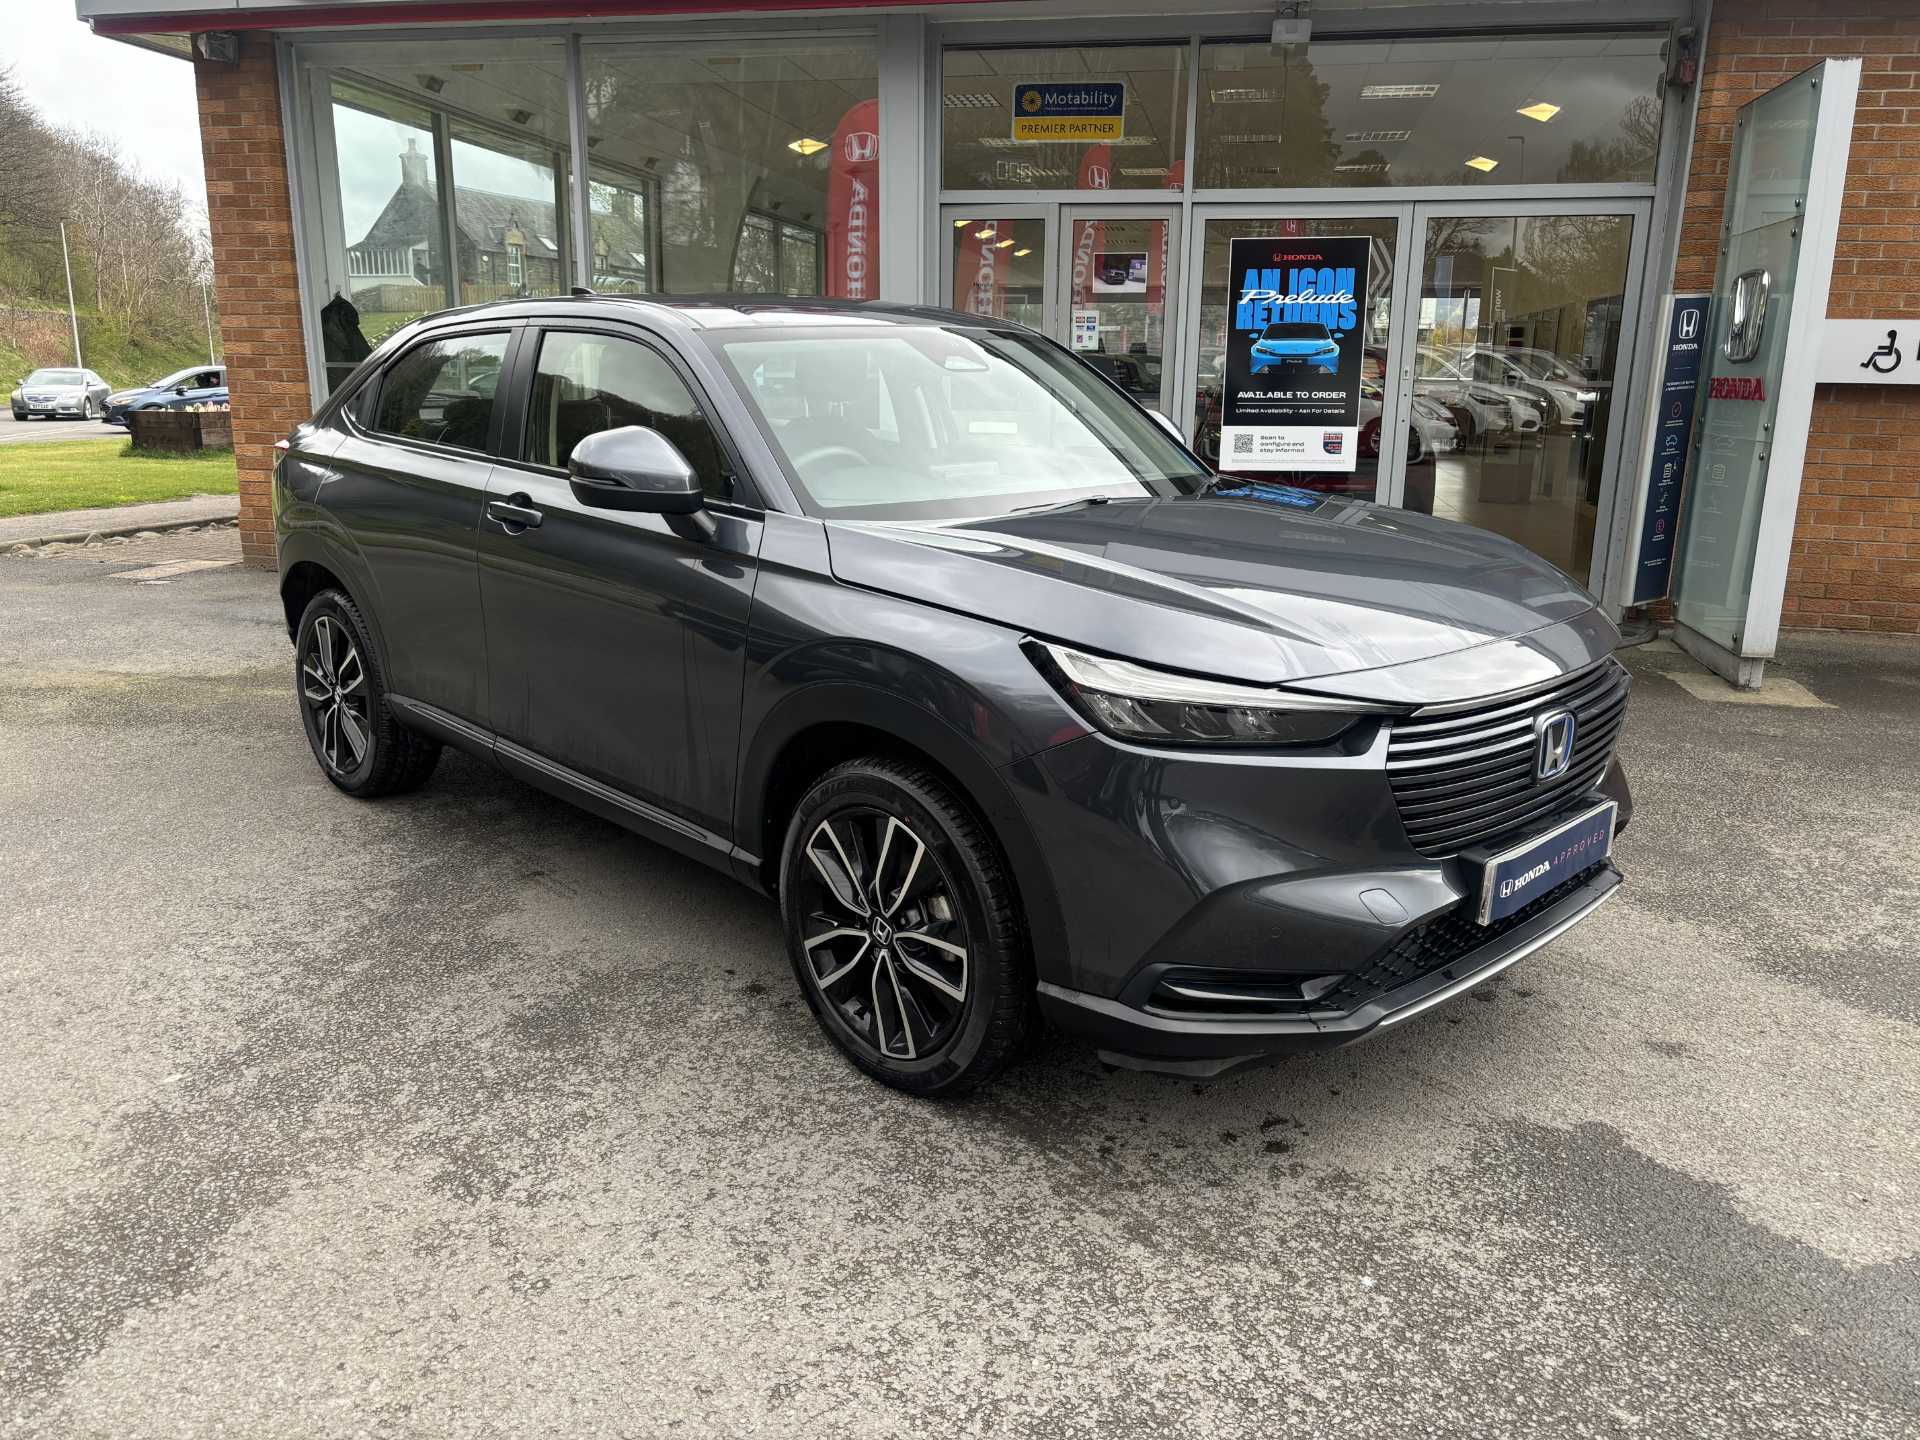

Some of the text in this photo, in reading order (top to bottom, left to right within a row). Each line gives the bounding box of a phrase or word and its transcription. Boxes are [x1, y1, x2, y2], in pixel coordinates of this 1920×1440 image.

[1044, 90, 1117, 108] Motability
[1021, 123, 1114, 134] PREMIER PARTNER
[1242, 267, 1355, 300] AN ICON
[1240, 288, 1355, 305] Prelude
[1235, 299, 1358, 330] RETURNS
[1672, 343, 1698, 351] HONDA
[1237, 391, 1347, 399] AVAILABLE TO ORDER
[1709, 376, 1766, 402] HONDA
[1514, 829, 1605, 891] HONDA APPROVED
